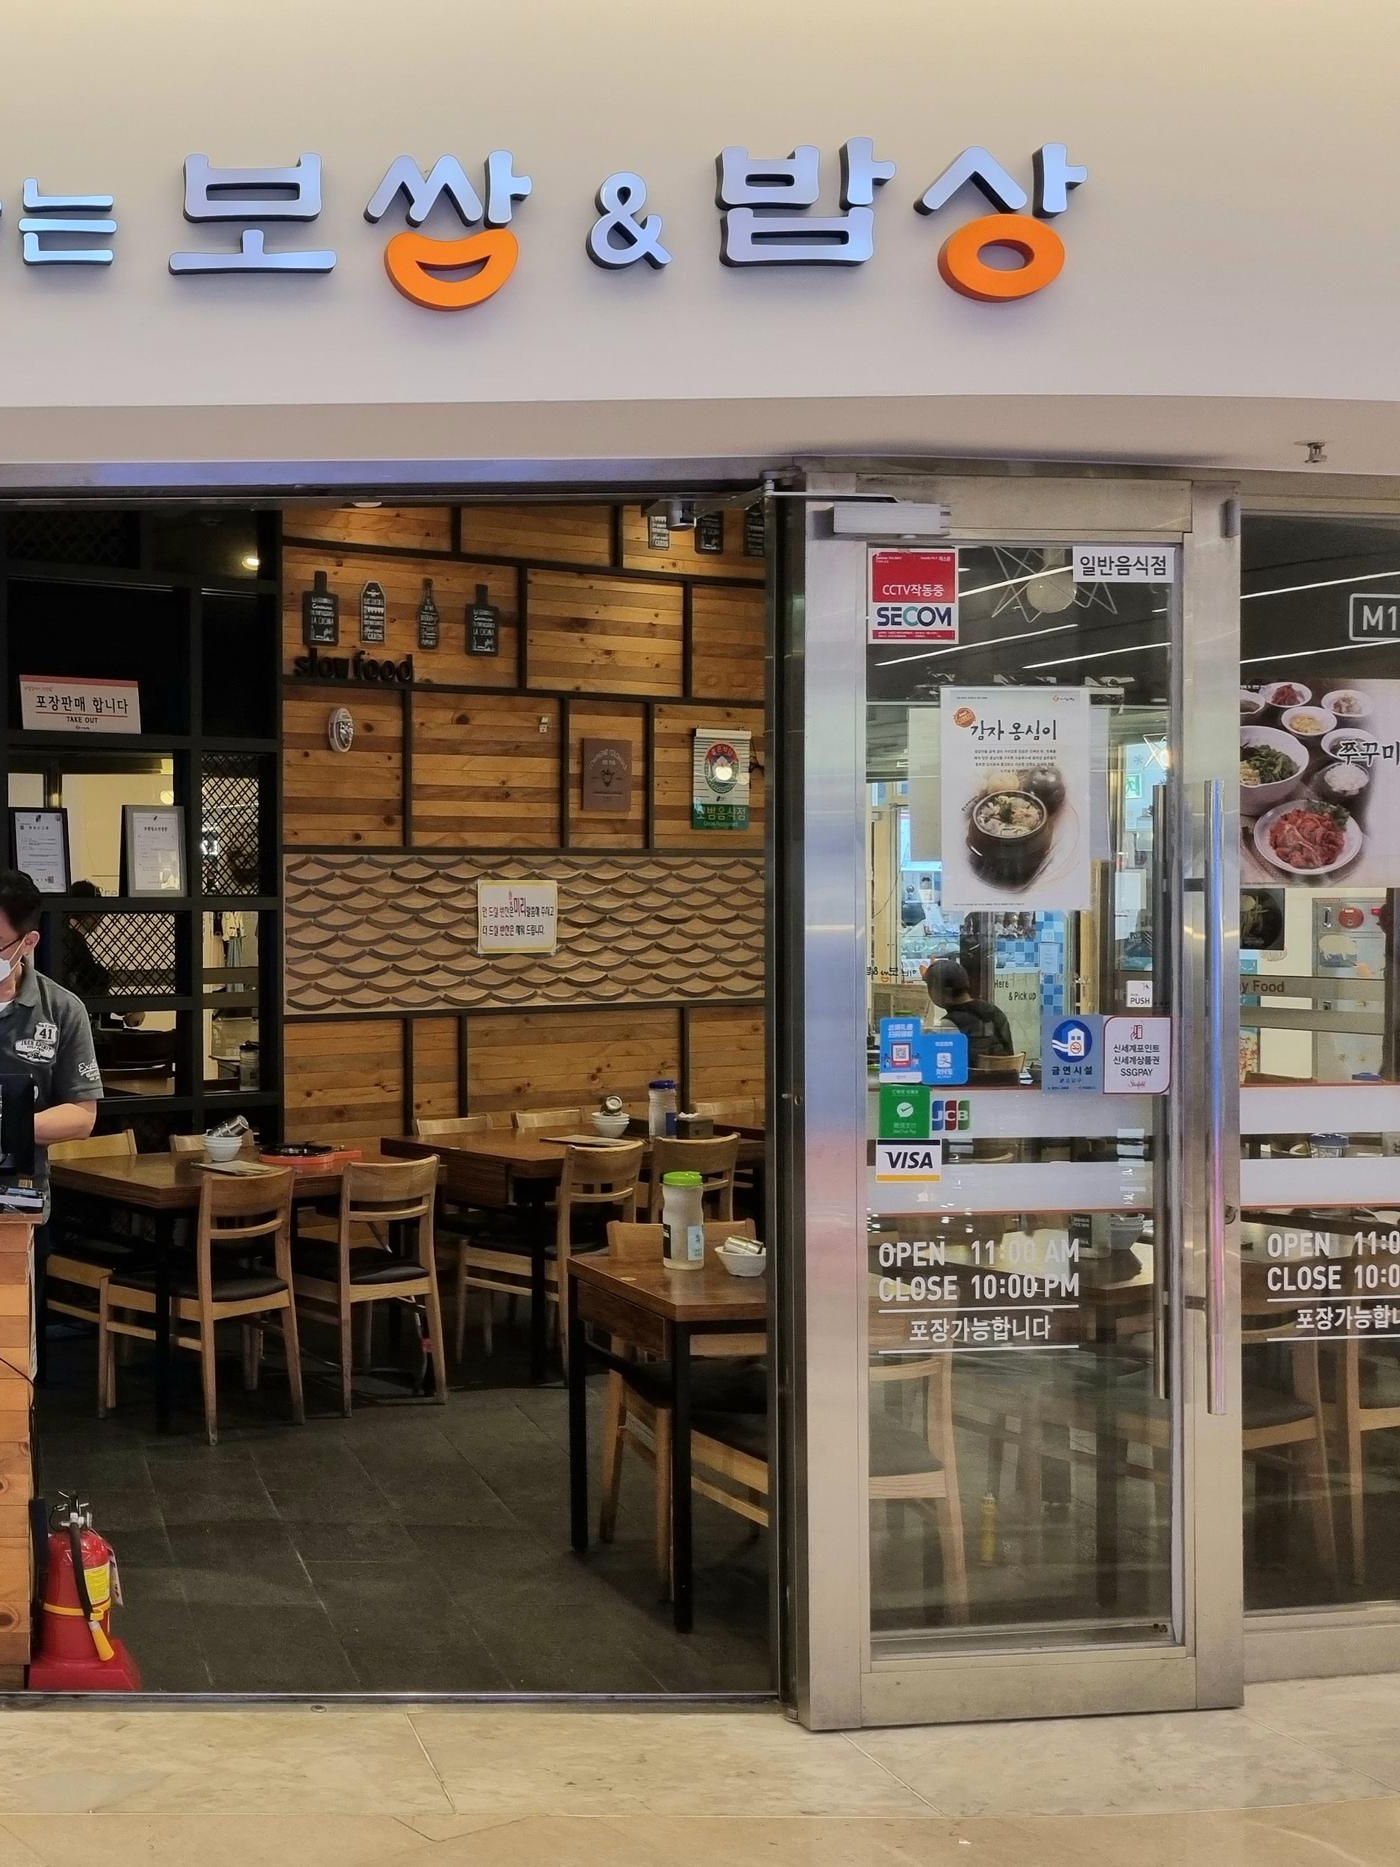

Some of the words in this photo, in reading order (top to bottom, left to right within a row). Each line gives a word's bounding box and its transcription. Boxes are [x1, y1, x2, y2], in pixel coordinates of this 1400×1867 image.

[586, 171, 674, 271] &
[716, 136, 1090, 304] 밥상
[1080, 555, 1166, 576] 일반음식점
[882, 583, 945, 597] CCTV작동중
[876, 606, 952, 627] SECOM
[293, 648, 350, 679] slow
[352, 650, 414, 683] food
[35, 695, 86, 713] 포장판매
[91, 696, 129, 714] 합니다
[85, 716, 98, 724] OUT
[970, 719, 1004, 741] 감자
[1008, 719, 1057, 741] 옹심이
[514, 897, 527, 917] 미리
[993, 979, 1009, 989] Here
[1253, 980, 1285, 993] Food
[1014, 991, 1026, 1001] Pick
[1028, 992, 1037, 1003] up
[1129, 997, 1151, 1005] PUSH
[39, 1028, 52, 1040] 41
[1113, 1044, 1160, 1054] 신세계포인트
[1112, 1055, 1160, 1066] 신세계상품권
[1051, 1065, 1093, 1076] 금연시설
[1120, 1068, 1153, 1077] SSGPAY
[884, 1151, 933, 1169] VISA
[878, 1240, 946, 1268] OPEN
[970, 1239, 1037, 1266] 11:00
[1044, 1237, 1080, 1264] AM
[1267, 1231, 1330, 1258] OPEN
[878, 1275, 959, 1302] CLOSE
[970, 1273, 1036, 1300] 10:00
[1044, 1272, 1080, 1298] PM
[1267, 1265, 1342, 1291] CLOSE
[909, 1314, 1051, 1343] 포장가능합니다
